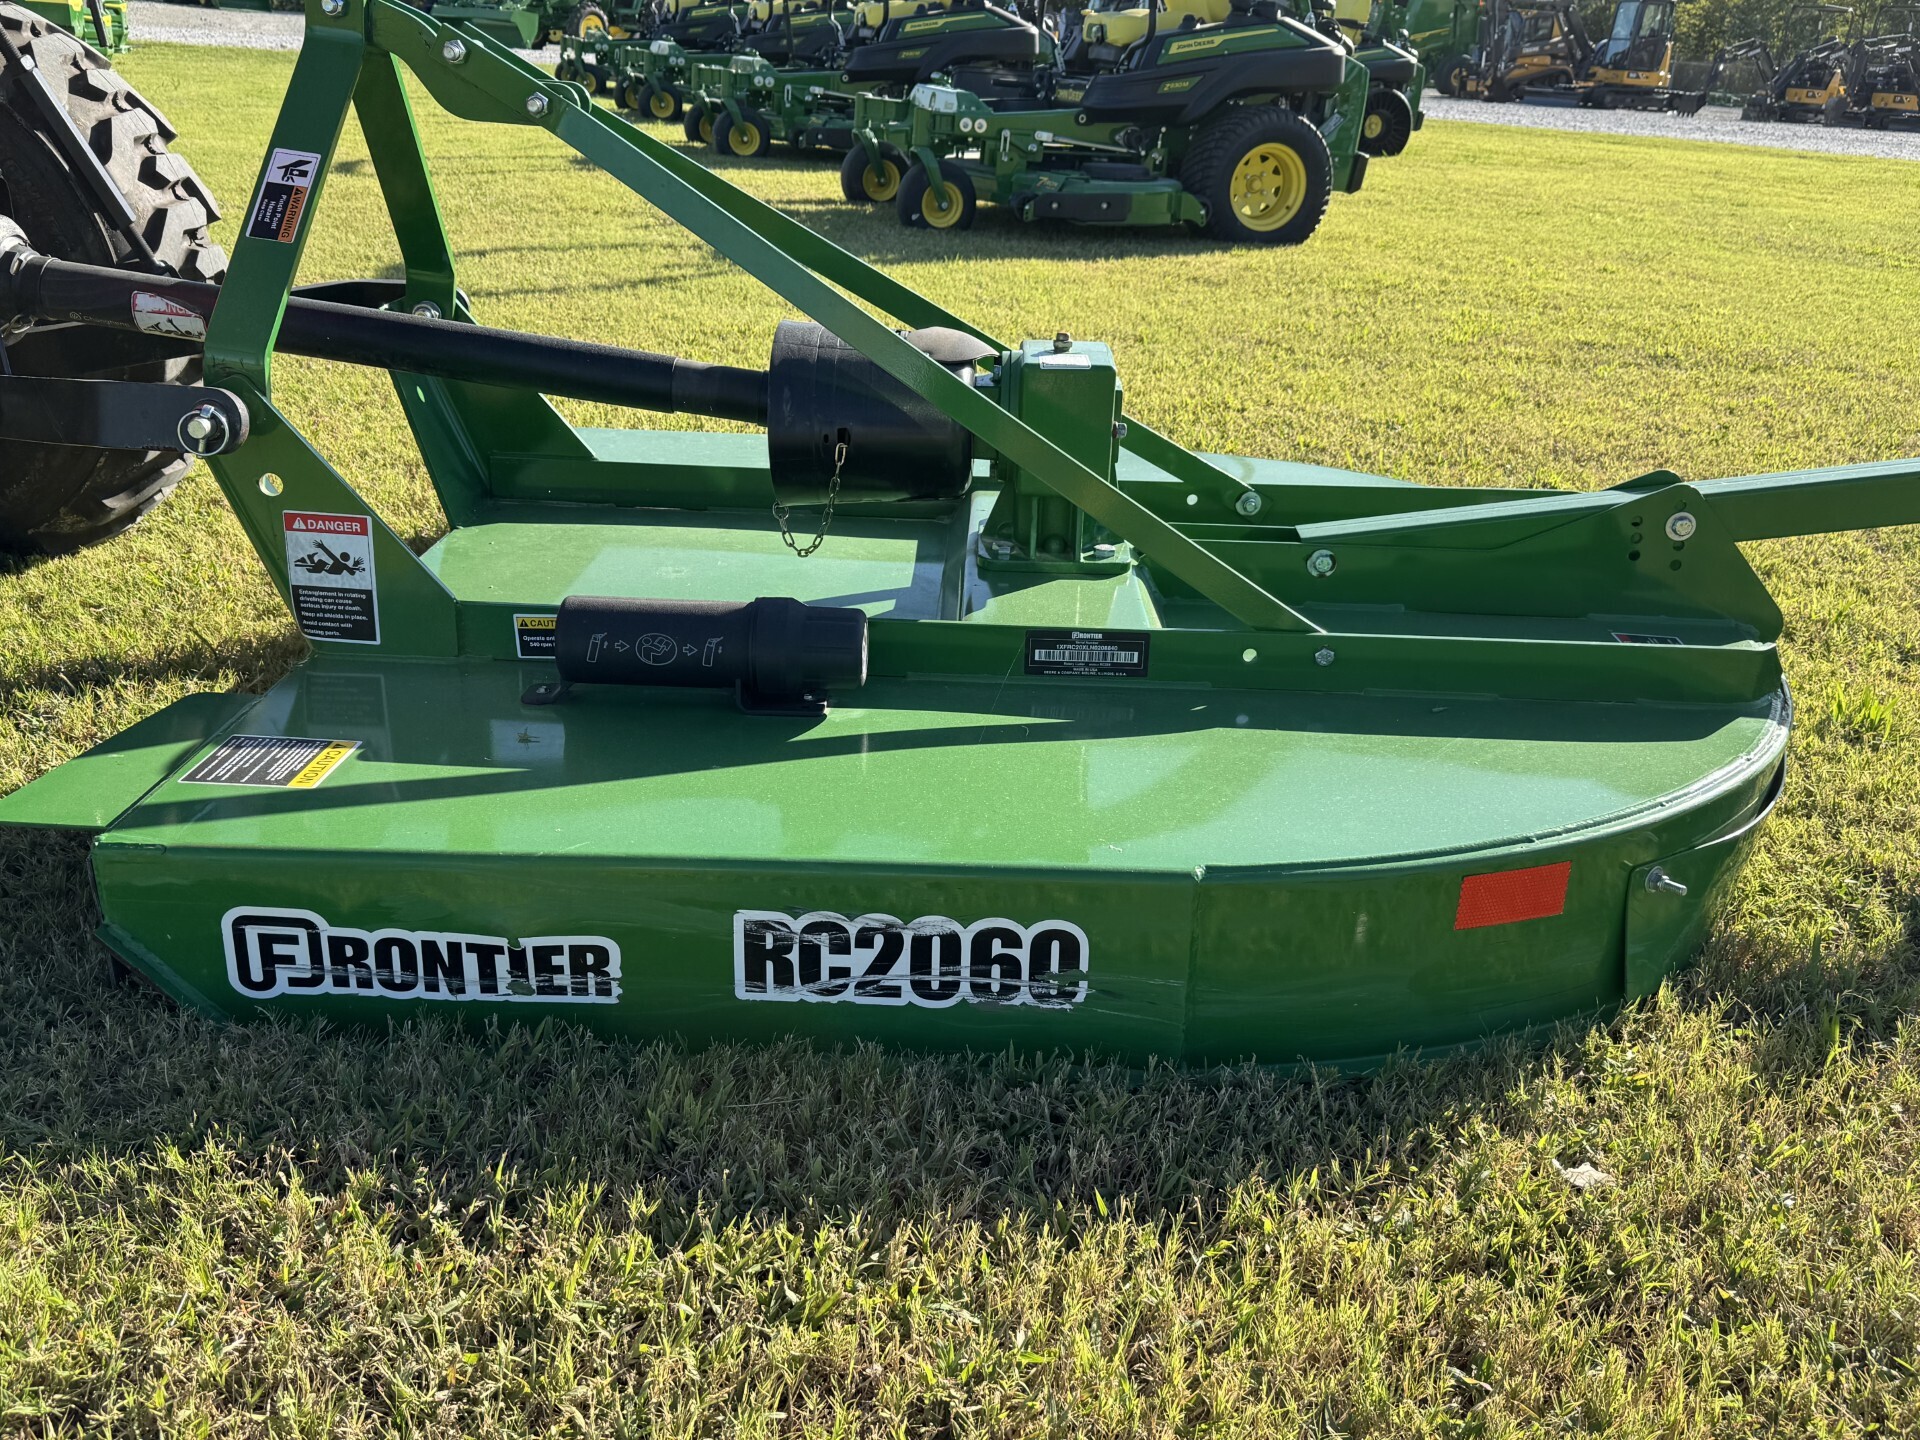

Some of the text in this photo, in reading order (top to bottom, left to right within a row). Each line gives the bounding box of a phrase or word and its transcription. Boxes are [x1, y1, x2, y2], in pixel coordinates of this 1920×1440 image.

[1193, 39, 1216, 47] DEERE
[1895, 45, 1912, 53] DEERE
[276, 194, 288, 212] Pinch
[270, 212, 281, 229] Point
[281, 196, 303, 238] WARNING
[307, 519, 361, 533] DANGER
[298, 588, 337, 597] Entanglement
[321, 603, 337, 611] injury
[530, 619, 555, 627] CAUT
[1071, 631, 1103, 640] FRONTIER
[296, 750, 342, 785] CAUTION
[230, 914, 614, 998] FRONTIER
[743, 917, 1083, 1004] RC2060
